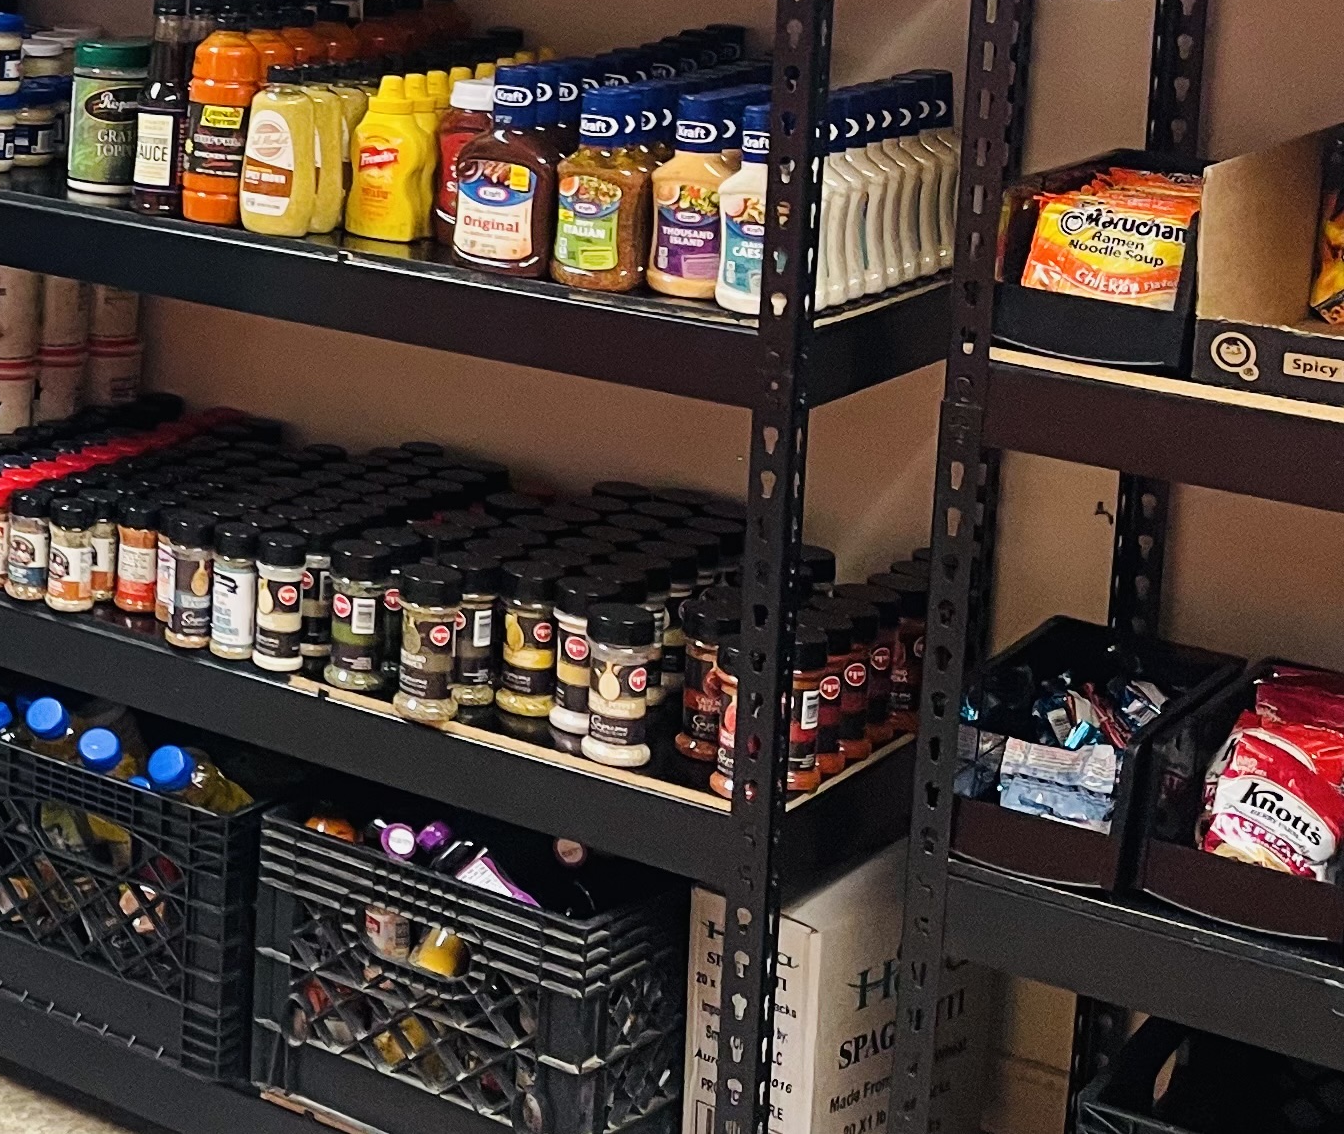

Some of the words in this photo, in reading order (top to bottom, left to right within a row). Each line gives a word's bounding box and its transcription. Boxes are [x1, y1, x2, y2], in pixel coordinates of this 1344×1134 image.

[495, 87, 524, 103] Kraft
[582, 119, 608, 133] Kraft
[677, 125, 707, 140] Kraft
[743, 134, 769, 149] Kraft
[139, 146, 168, 162] AUCE
[482, 188, 502, 200] Kraft
[463, 214, 520, 234] Original
[563, 225, 606, 240] ITALIAN
[662, 225, 714, 240] THOUSAND
[669, 236, 704, 248] ISLAND
[1092, 231, 1145, 252] Ramen
[733, 245, 763, 260] CAES
[1068, 239, 1122, 259] Noodle
[1124, 249, 1165, 268] Soup
[1292, 357, 1339, 378] Spicy
[1240, 780, 1323, 846] Knott's
[829, 1088, 861, 1115] Made
